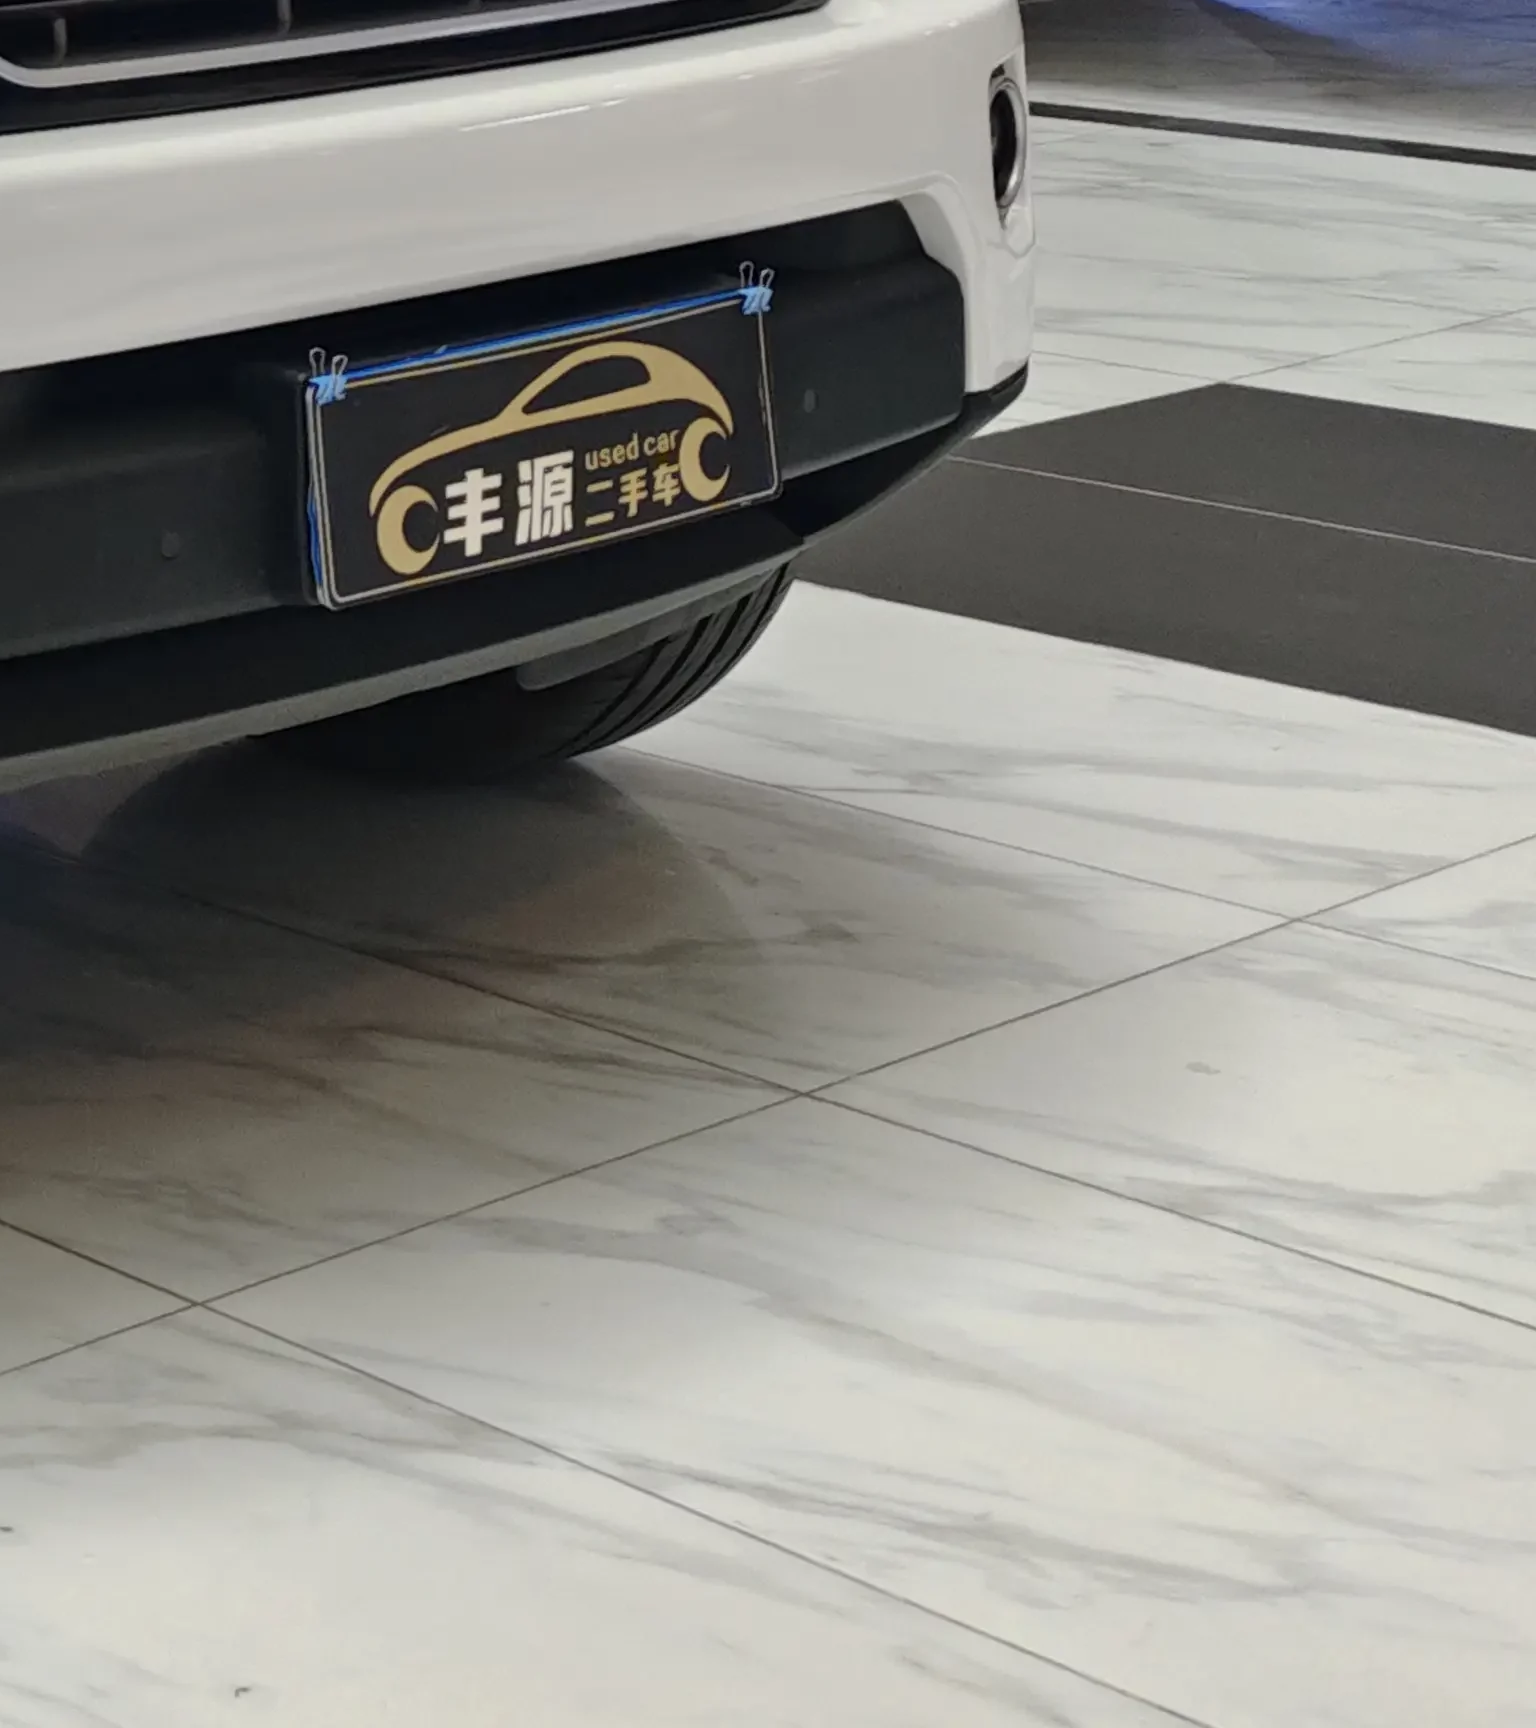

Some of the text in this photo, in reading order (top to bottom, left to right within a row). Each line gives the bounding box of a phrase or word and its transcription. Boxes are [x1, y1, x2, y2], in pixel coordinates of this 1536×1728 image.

[585, 428, 680, 470] used car
[443, 449, 575, 557] 丰源
[585, 462, 681, 527] 二手车
